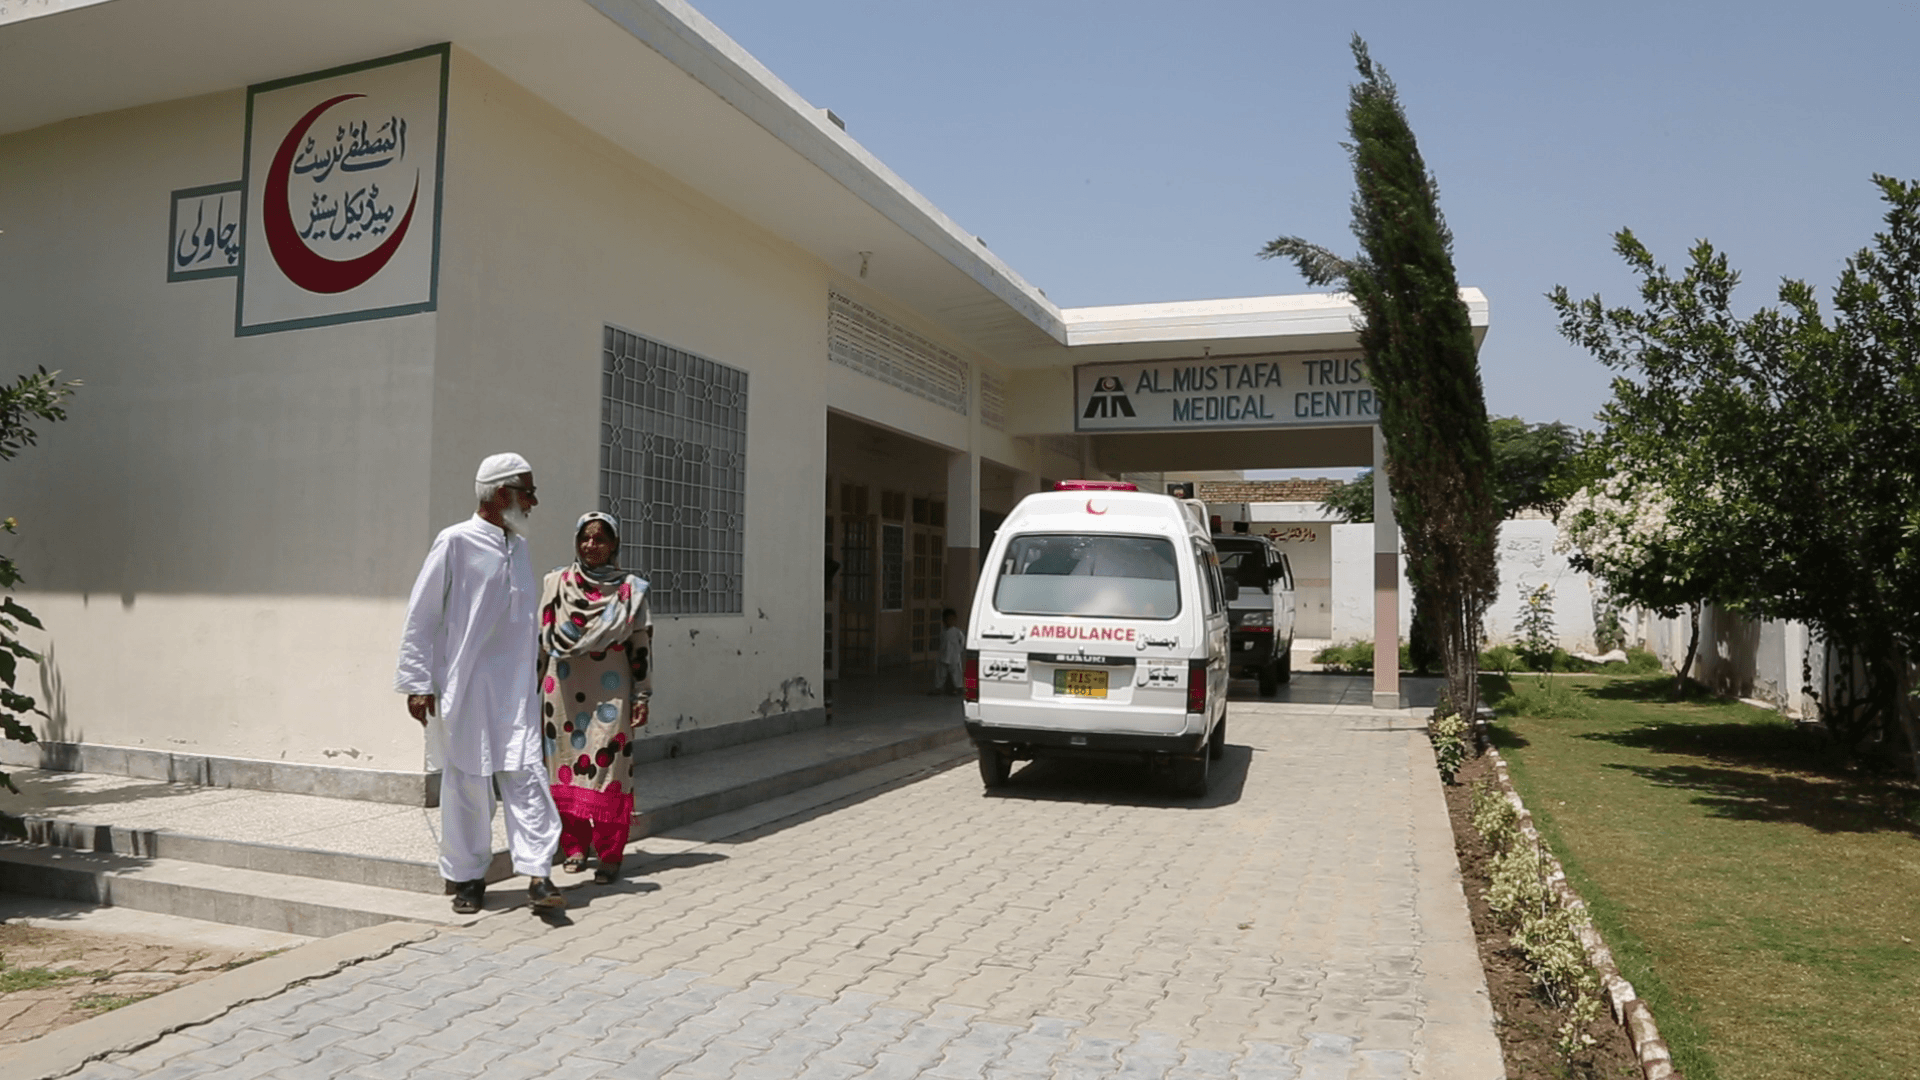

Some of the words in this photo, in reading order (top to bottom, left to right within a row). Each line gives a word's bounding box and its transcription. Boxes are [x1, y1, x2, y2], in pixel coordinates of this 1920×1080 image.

[1302, 358, 1363, 385] TRUS
[1173, 394, 1274, 421] MEDICAL
[1030, 625, 1136, 642] AMBULANCE
